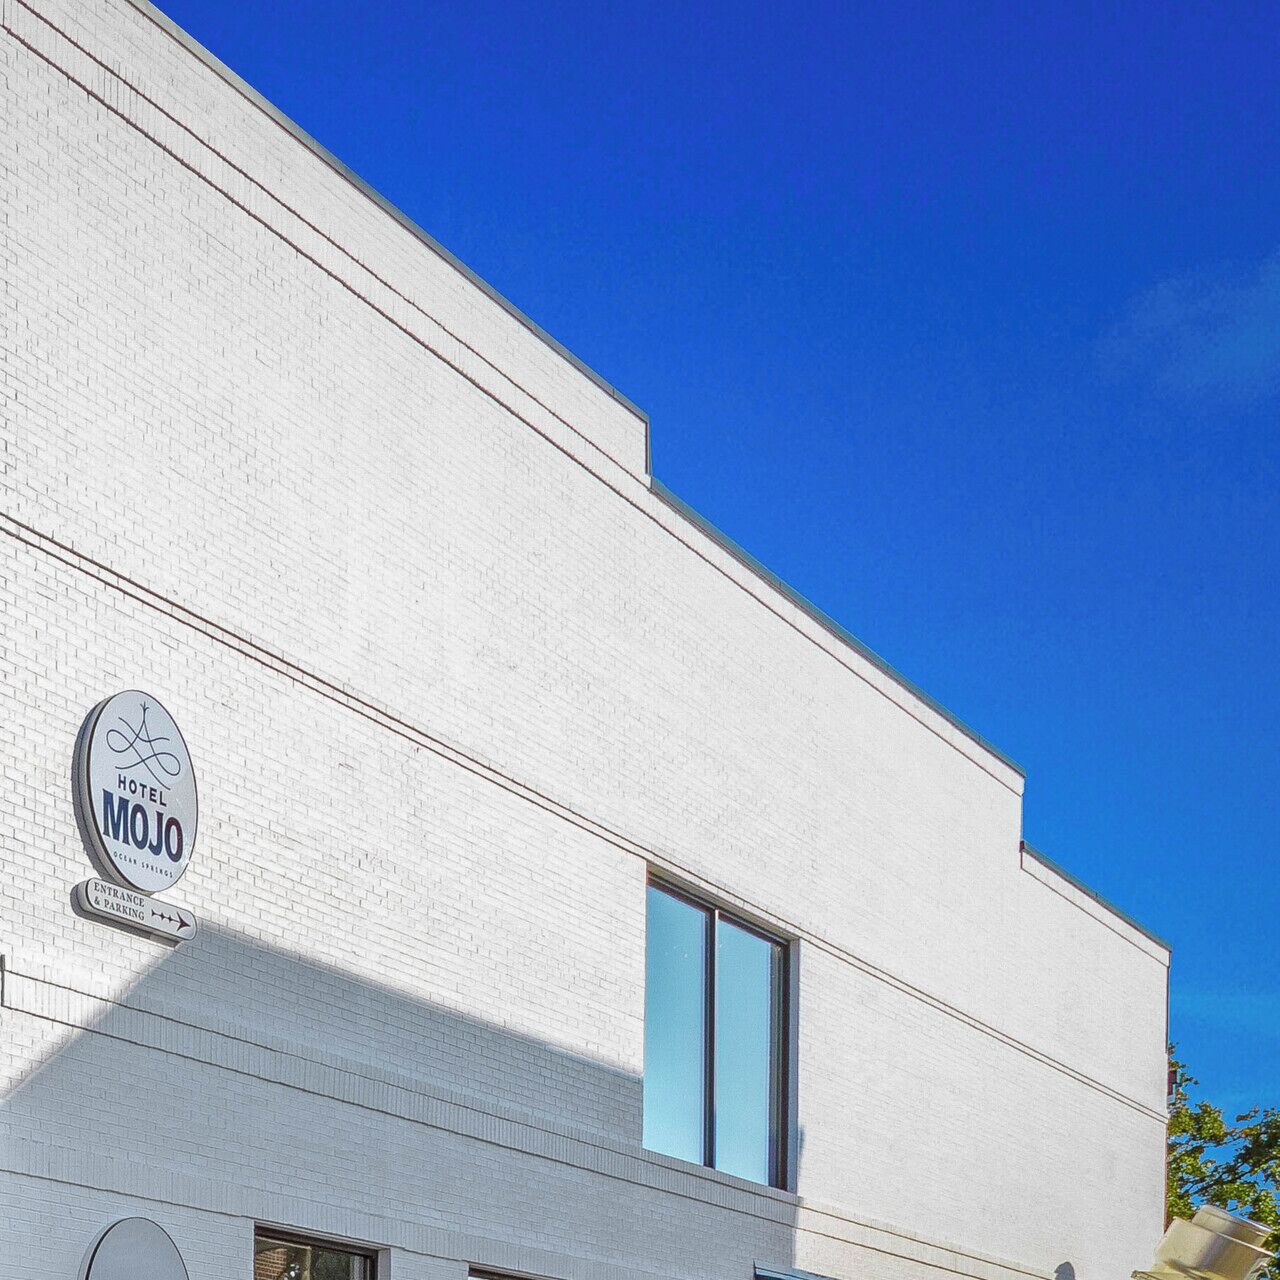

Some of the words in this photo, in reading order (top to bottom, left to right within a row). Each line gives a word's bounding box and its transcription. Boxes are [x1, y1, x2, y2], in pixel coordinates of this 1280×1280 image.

[117, 774, 167, 807] HOTEL
[102, 788, 184, 863] MOJO
[113, 850, 137, 866] OCEAN
[141, 860, 174, 878] SPRINGS
[94, 882, 145, 908] ENTRANCE
[94, 896, 101, 906] &
[104, 900, 145, 921] PARKING
